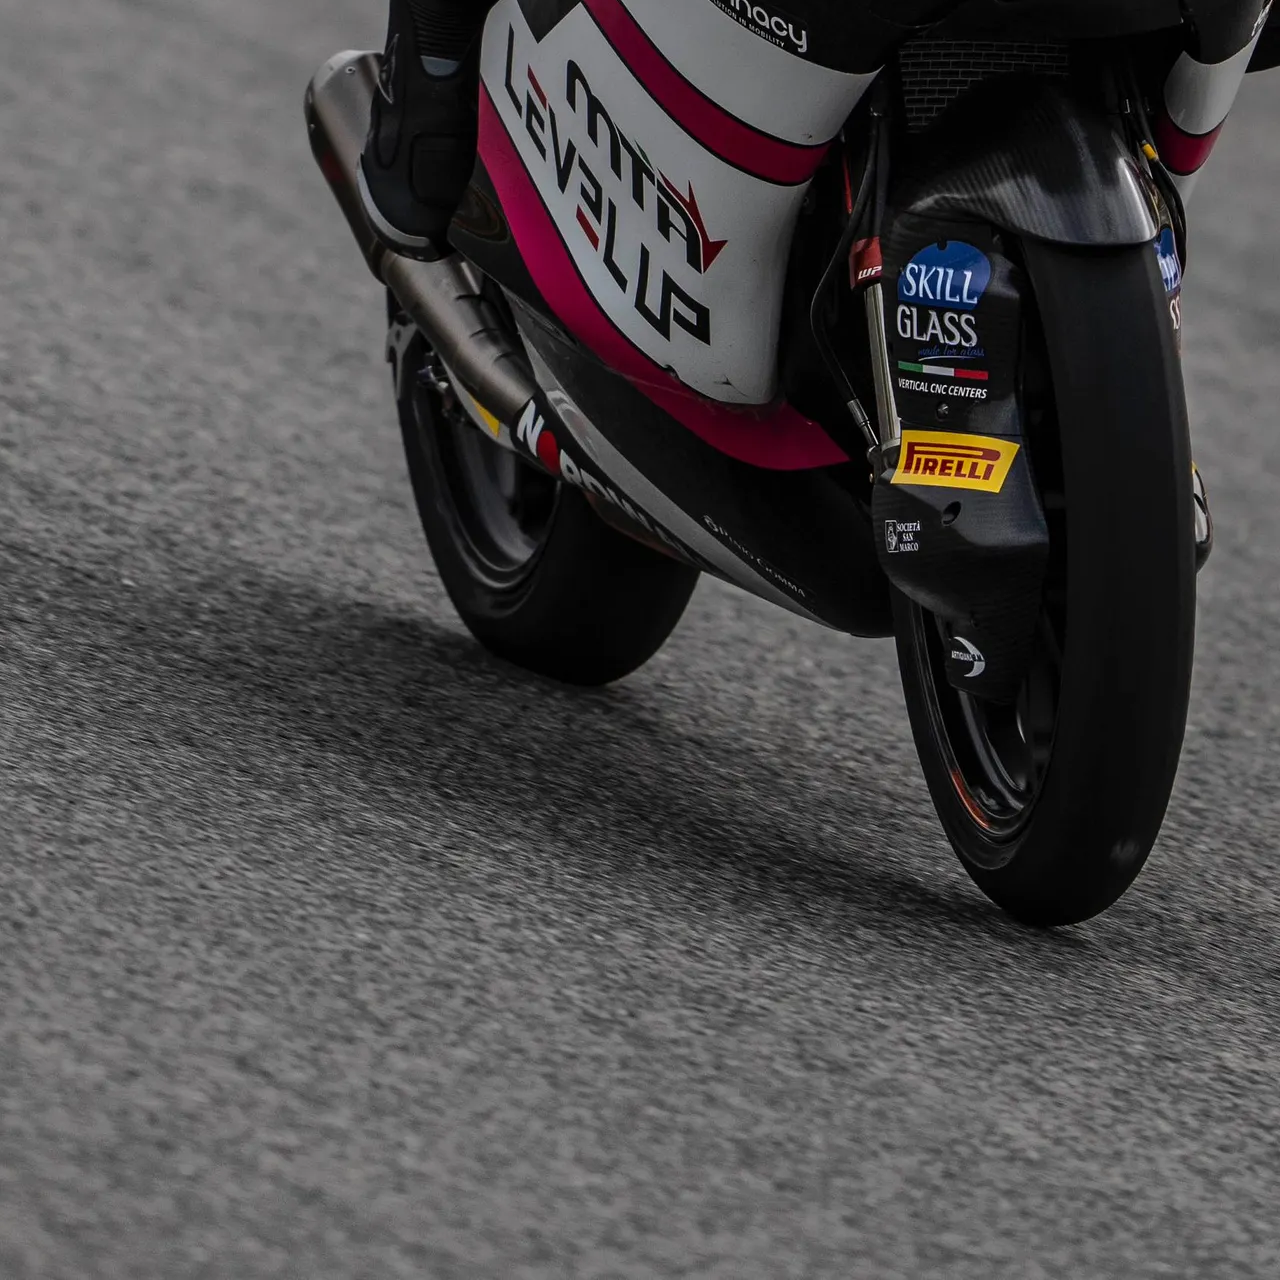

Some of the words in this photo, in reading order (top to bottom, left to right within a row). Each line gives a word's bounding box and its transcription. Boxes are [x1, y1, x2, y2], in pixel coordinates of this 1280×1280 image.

[748, 23, 785, 48] MOBILITY
[504, 22, 711, 346] LEVELUP
[857, 265, 883, 280] WP
[902, 262, 978, 304] SKILL
[896, 303, 978, 348] GLASS
[898, 377, 929, 393] VERTICAL
[930, 383, 948, 395] CNC
[948, 385, 988, 399] CENTERS
[901, 441, 1001, 481] PIRELLI
[896, 520, 921, 532] SOCIETÀ
[902, 532, 914, 541] SAN
[899, 542, 919, 552] MARCO
